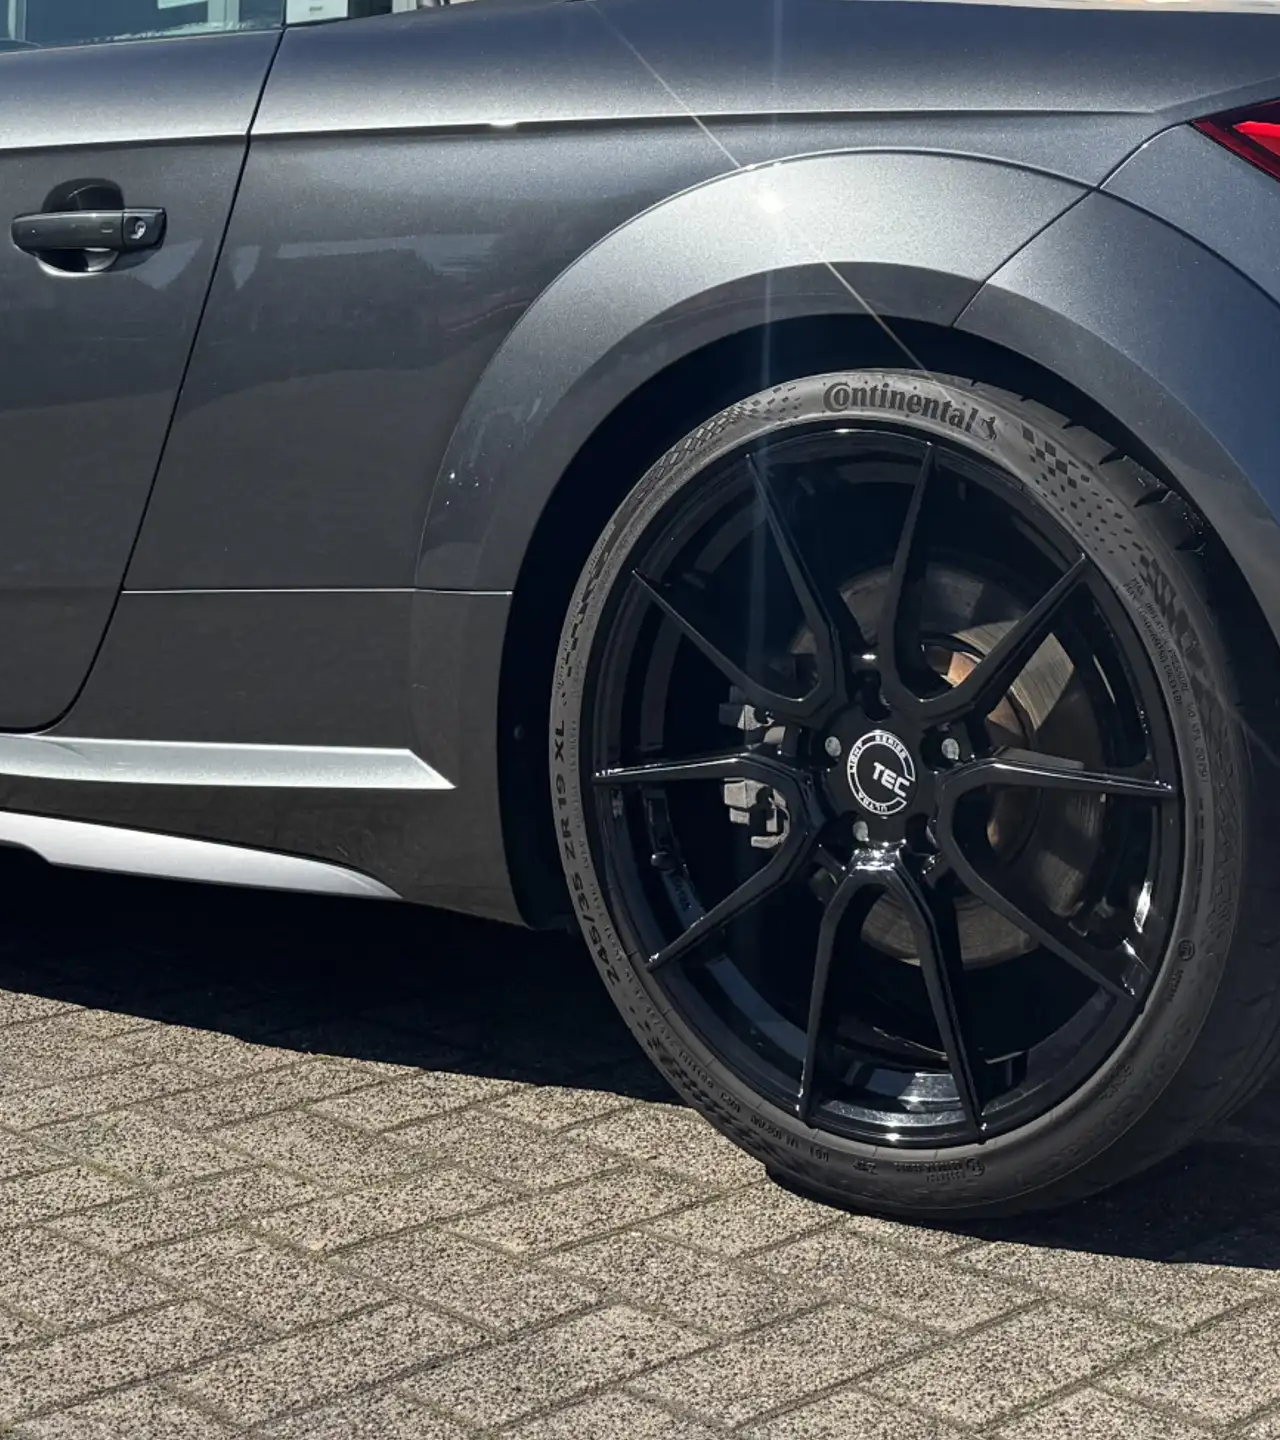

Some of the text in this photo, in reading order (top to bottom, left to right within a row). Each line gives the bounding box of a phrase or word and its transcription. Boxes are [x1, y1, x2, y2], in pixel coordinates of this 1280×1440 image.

[823, 382, 980, 433] Continental
[872, 761, 910, 798] TEC
[571, 871, 621, 986] 245/35
